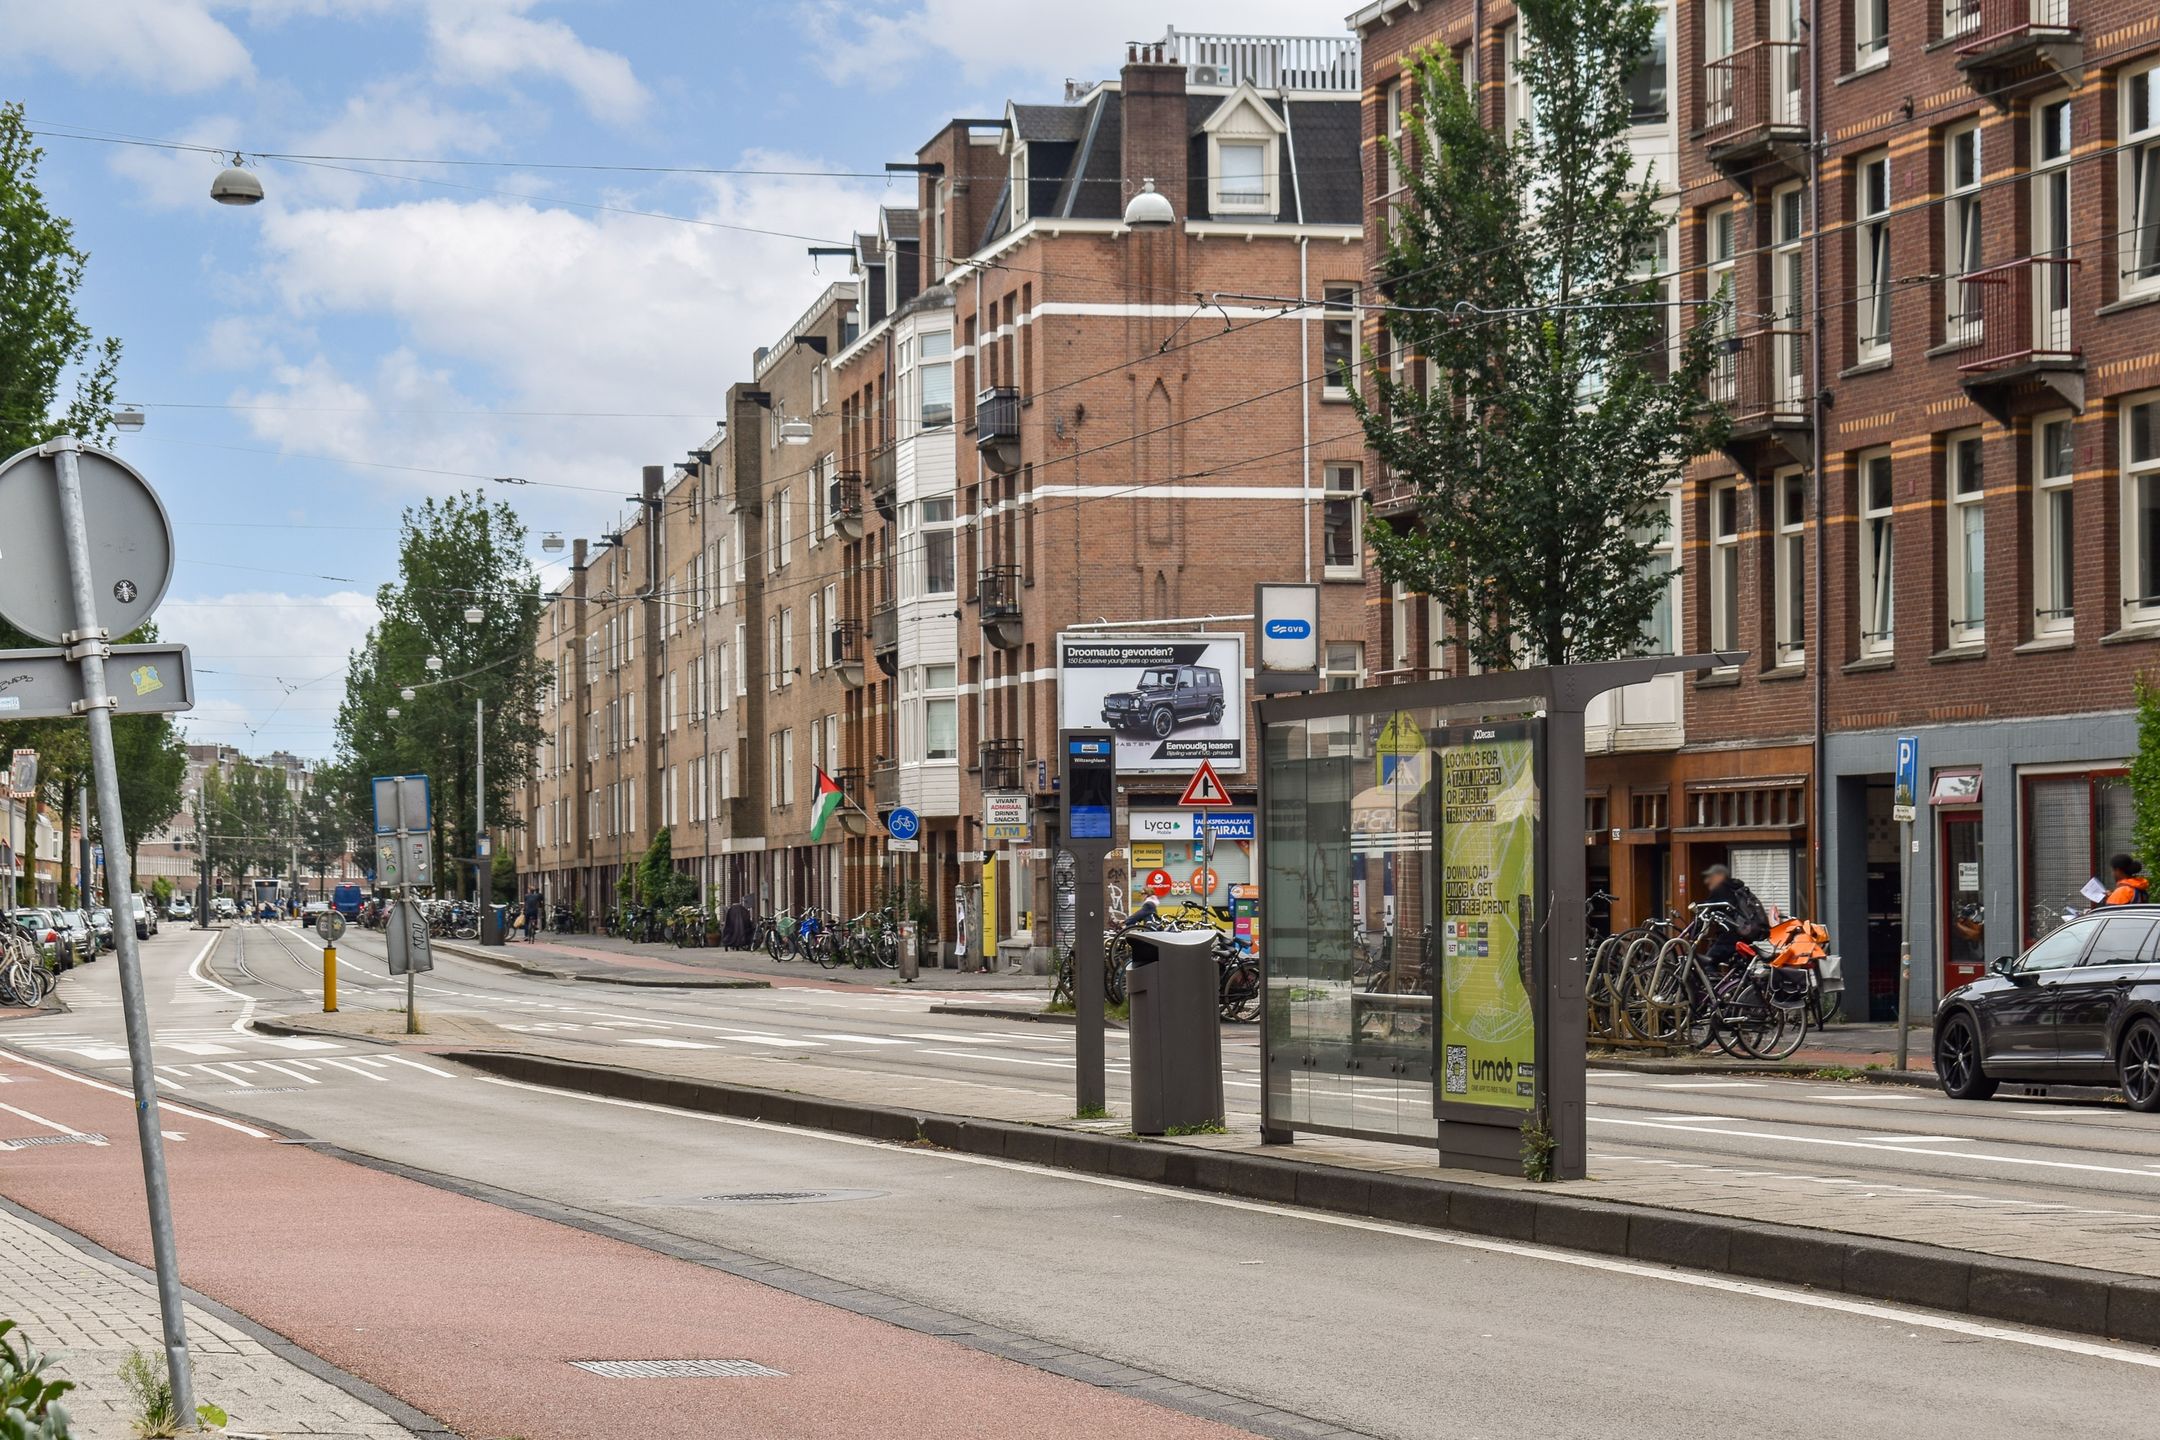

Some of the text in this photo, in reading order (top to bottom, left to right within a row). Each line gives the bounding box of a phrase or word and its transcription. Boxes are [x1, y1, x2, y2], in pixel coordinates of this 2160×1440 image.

[1067, 647, 1174, 658] Droomauto gevonden?
[1473, 730, 1495, 740] JCDecaux
[1166, 742, 1233, 751] Eenvoudig leasen
[1446, 750, 1498, 768] LOOKING FOR
[1900, 743, 1911, 776] P
[1447, 769, 1501, 787] A TAXI MOPED
[1446, 788, 1488, 804] OR PUBLIC
[1446, 805, 1496, 823] TRANSPORT?
[994, 827, 1020, 836] ATM
[1144, 820, 1171, 831] Lyca
[1195, 825, 1251, 835] AMIRAAL
[1446, 865, 1489, 880] DOWNLOAD
[1446, 882, 1493, 897] UMOB & GET
[1446, 899, 1510, 915] €10 FREE CREDIT
[1472, 1057, 1513, 1083] umob
